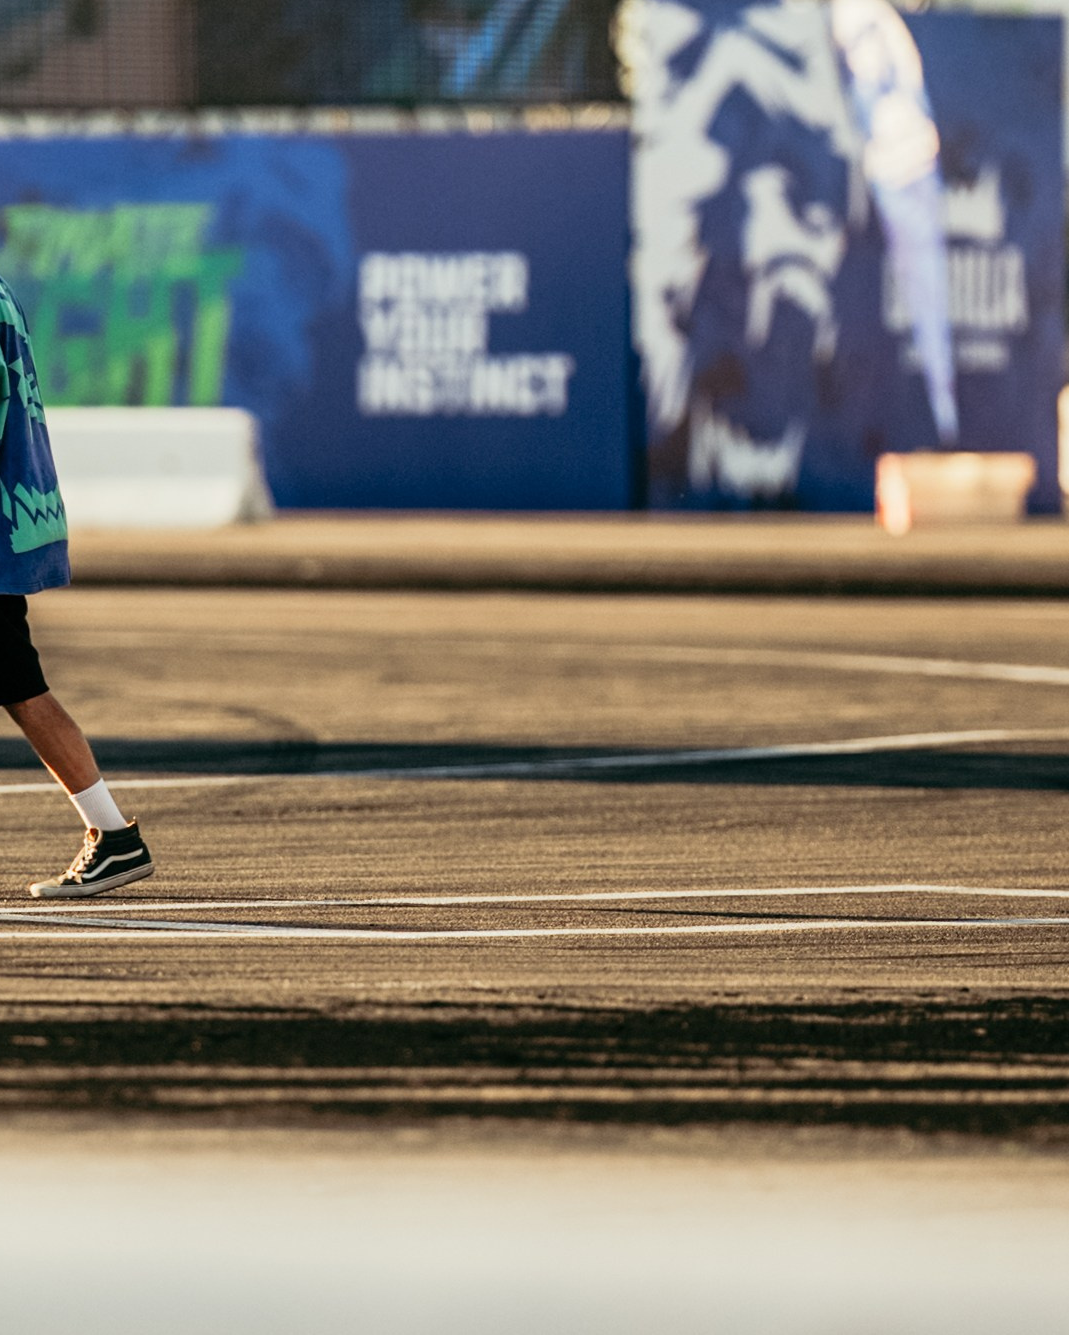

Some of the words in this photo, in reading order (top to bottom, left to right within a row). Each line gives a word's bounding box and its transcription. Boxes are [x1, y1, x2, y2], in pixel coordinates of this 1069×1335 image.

[360, 251, 528, 310] POWER
[363, 302, 488, 358] YOUR
[359, 354, 573, 413] INSTINCT
